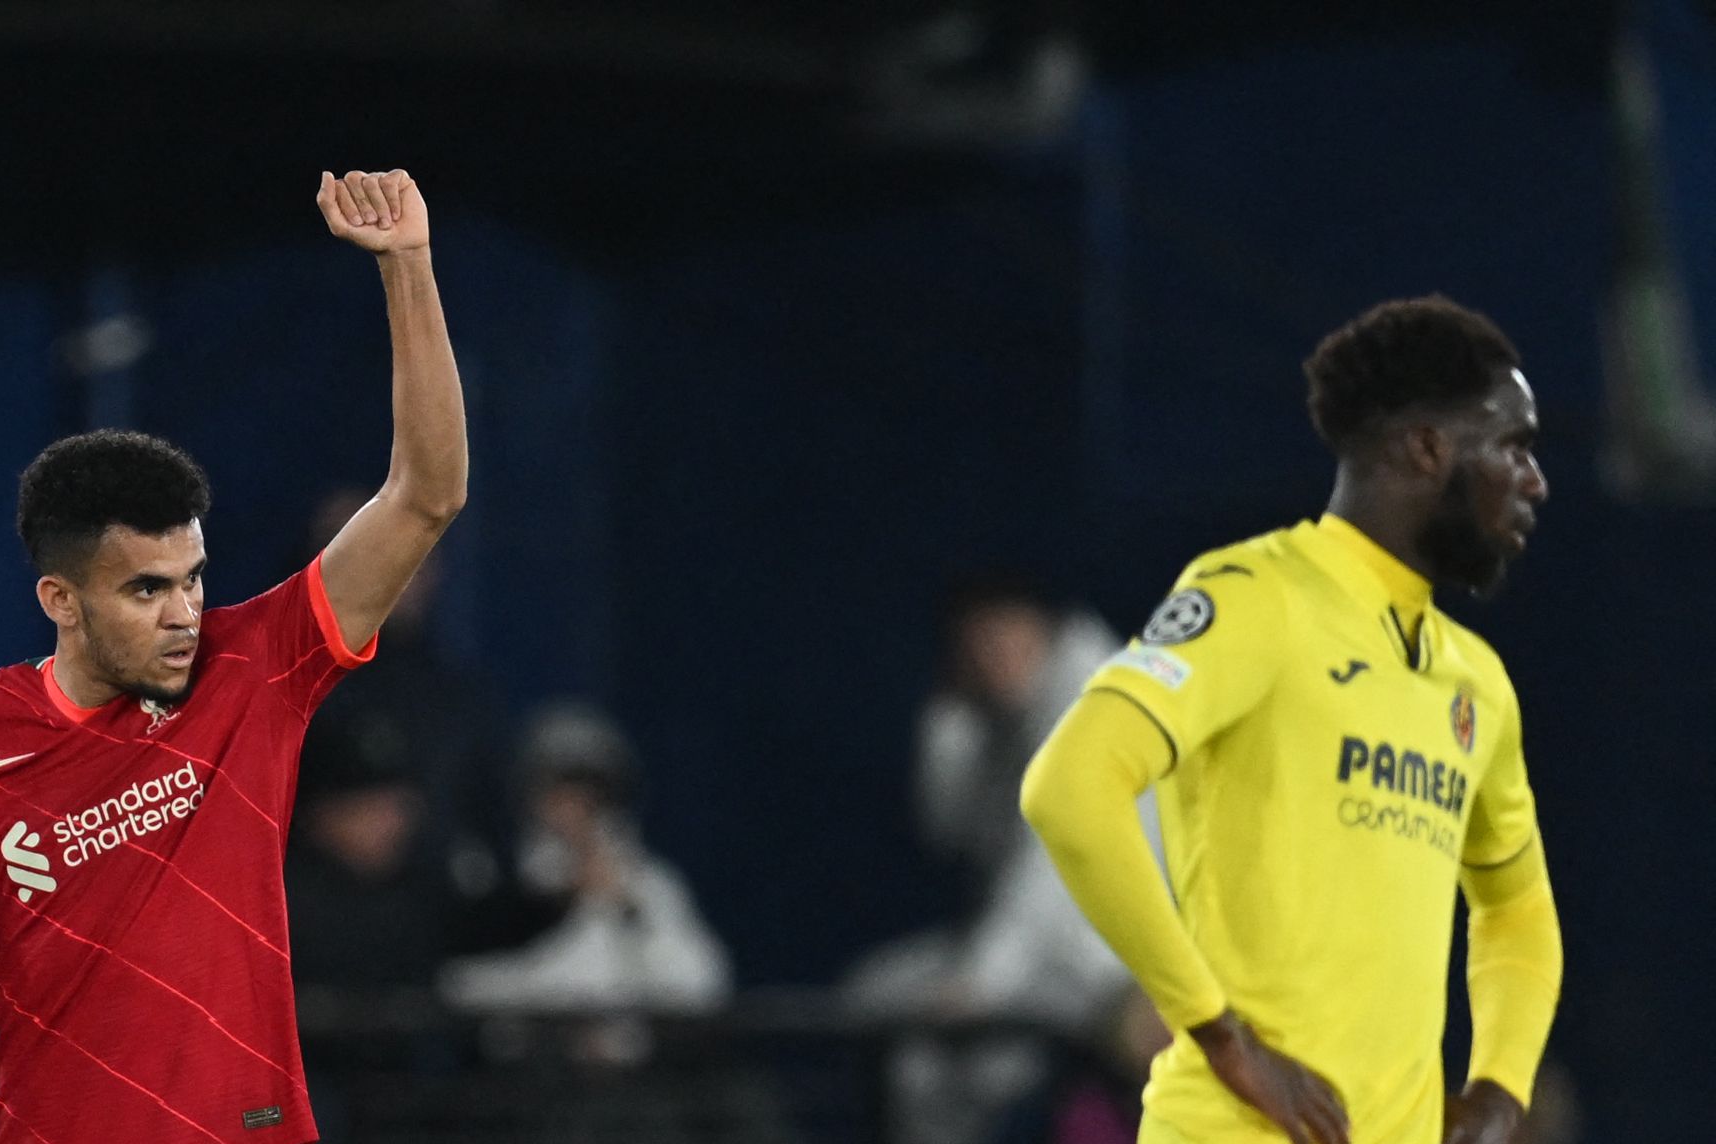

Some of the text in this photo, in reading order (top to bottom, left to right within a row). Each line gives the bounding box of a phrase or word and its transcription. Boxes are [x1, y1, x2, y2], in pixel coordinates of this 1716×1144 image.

[53, 761, 198, 844] standard
[1337, 734, 1467, 821] PAMESA
[62, 783, 205, 868] chartered
